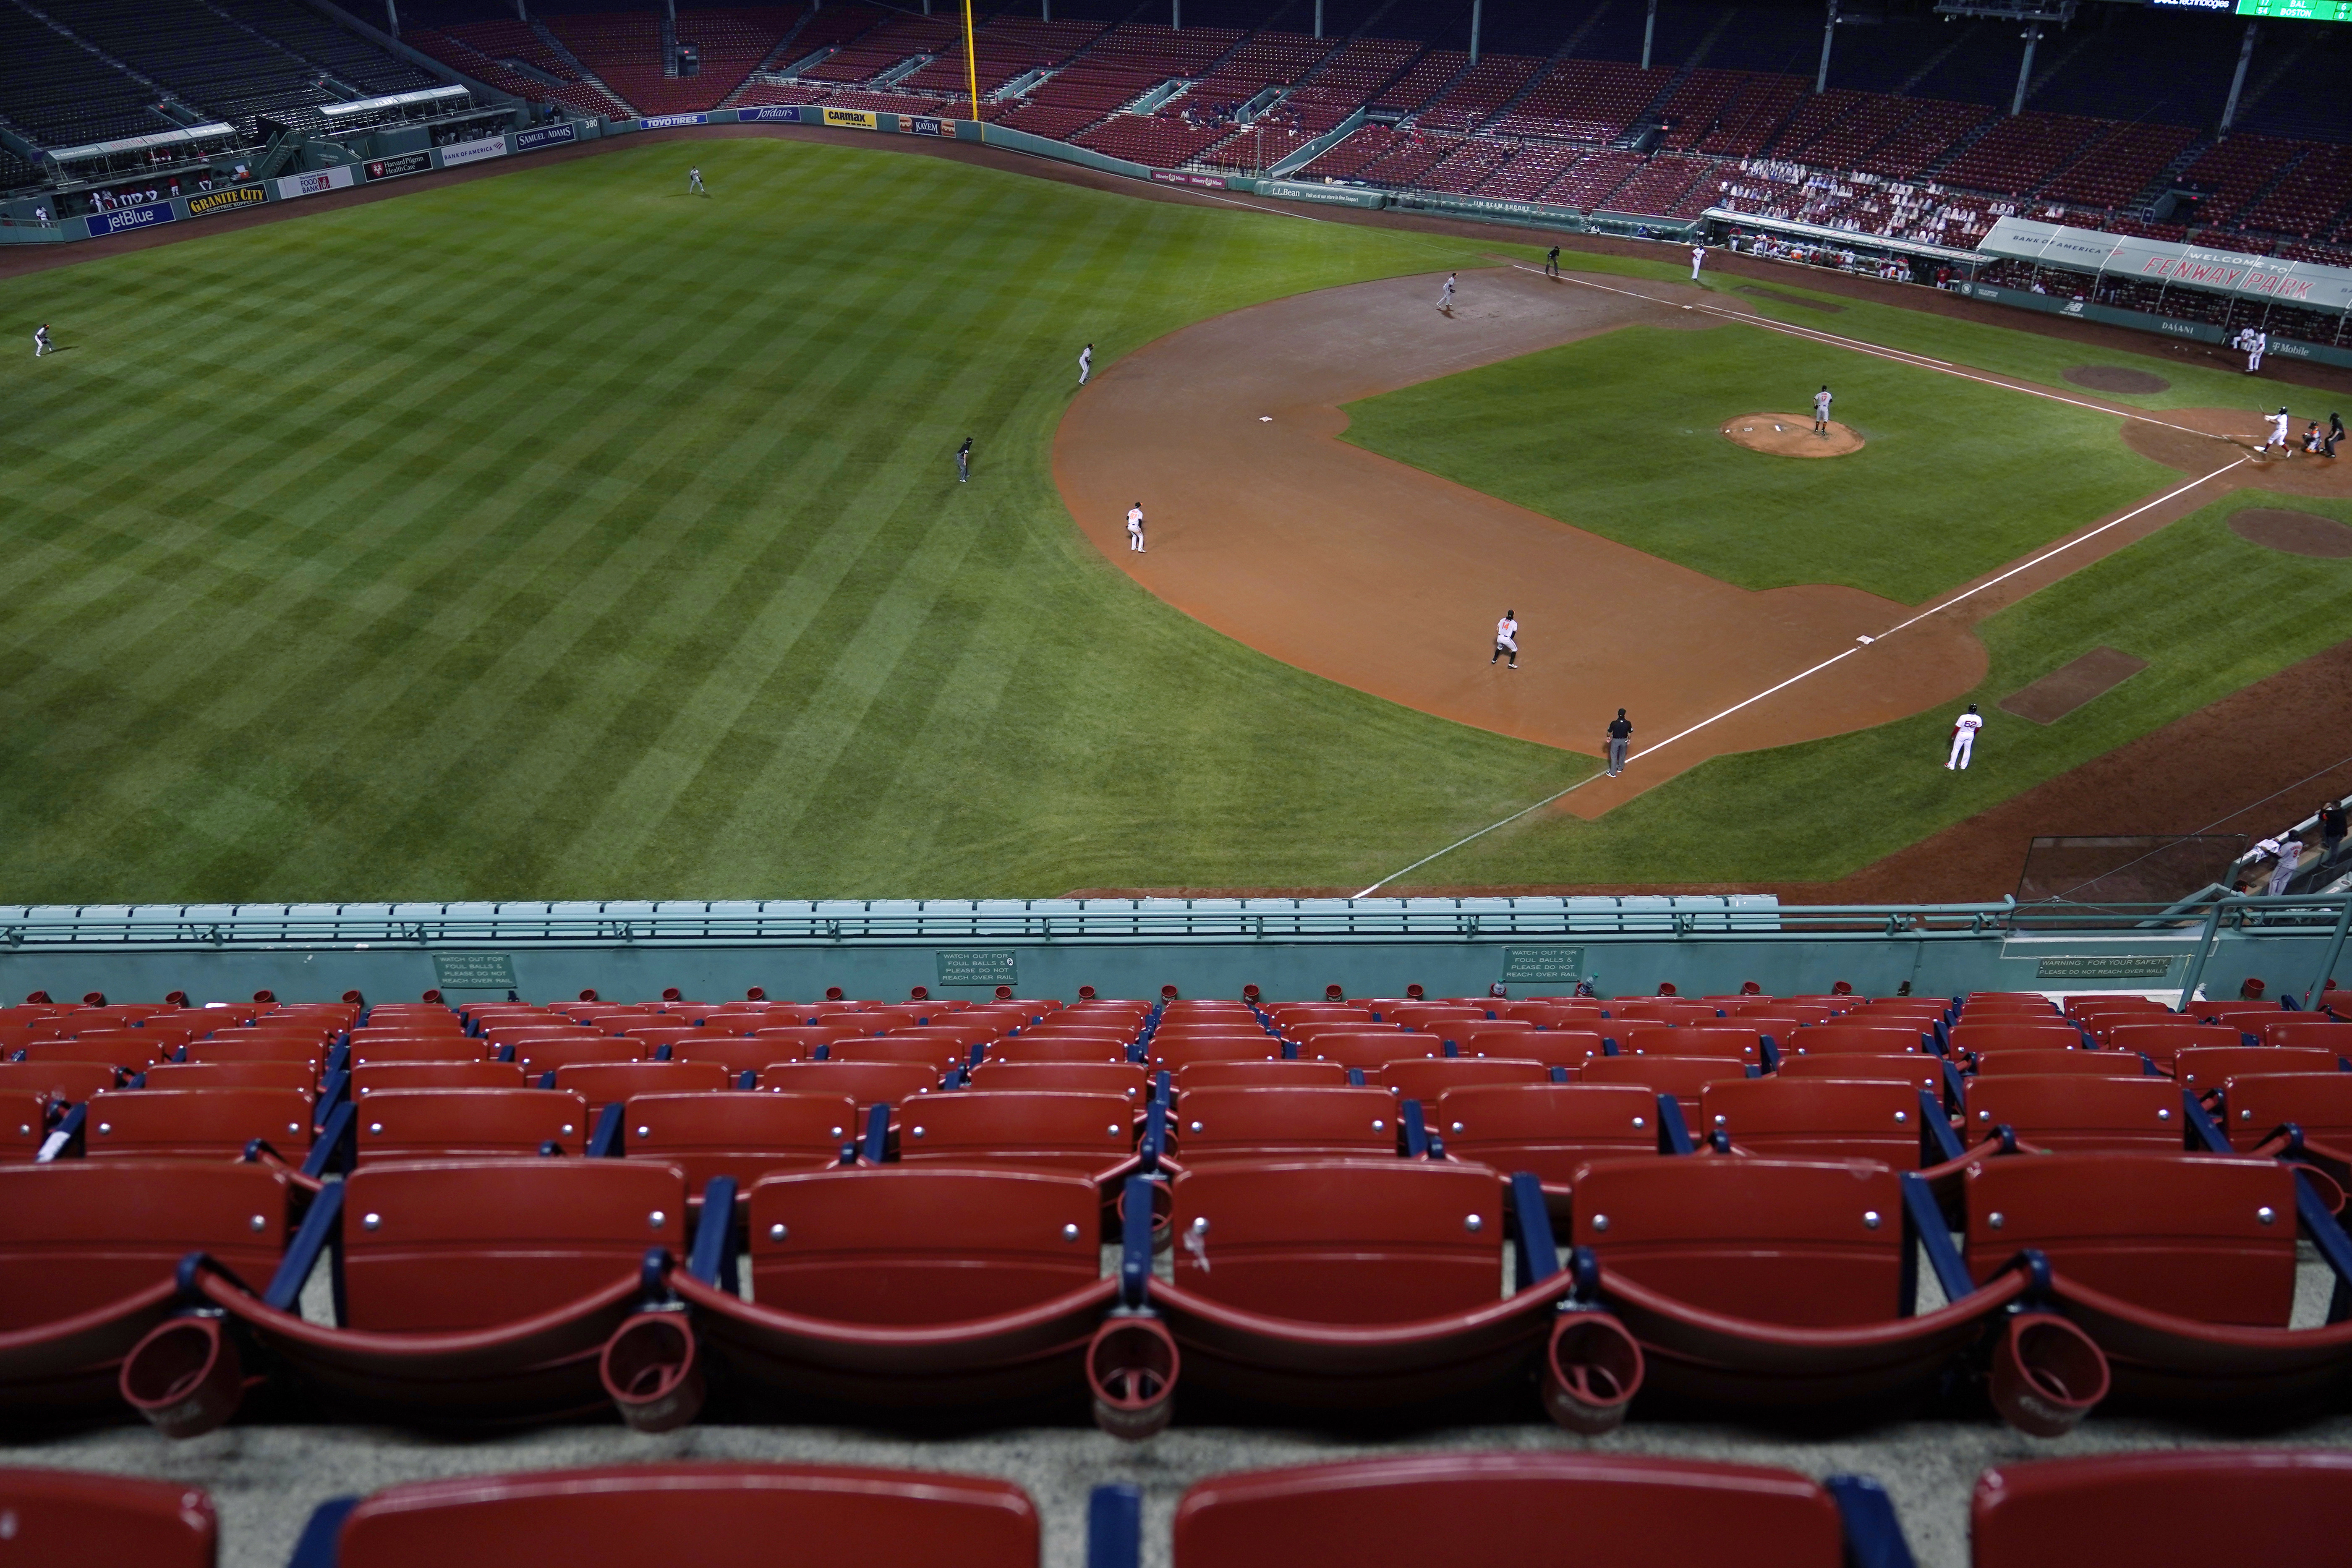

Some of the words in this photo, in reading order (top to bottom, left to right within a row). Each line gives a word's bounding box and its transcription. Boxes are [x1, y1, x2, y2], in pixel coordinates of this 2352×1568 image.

[2280, 8, 2312, 17] BOSTON
[755, 108, 792, 120] Jordan's
[585, 119, 598, 128] 380
[647, 118, 672, 127] TOYO
[672, 116, 697, 125] TIRES
[916, 122, 938, 134] KAYEM
[519, 133, 545, 146] SAMUEL
[548, 126, 572, 138] ADAMS
[469, 146, 493, 155] AMERICA
[384, 159, 405, 168] Harvard
[406, 156, 424, 165] Pilgrim
[386, 166, 404, 175] Health
[301, 178, 317, 187] FOOD
[302, 185, 320, 193] BANK
[190, 189, 238, 213] GRANITE
[240, 186, 264, 201] CITY
[206, 204, 233, 212] ELECTRIC
[107, 210, 154, 232] jetBlue
[2057, 243, 2101, 253] AMERICA
[2190, 253, 2264, 268] WELCOME
[2269, 264, 2289, 273] TO
[2142, 257, 2242, 286] FENWAY
[2243, 272, 2315, 300] PARK
[2162, 322, 2194, 334] DASANI
[2280, 344, 2309, 356] Mobile
[1502, 622, 1510, 630] 14
